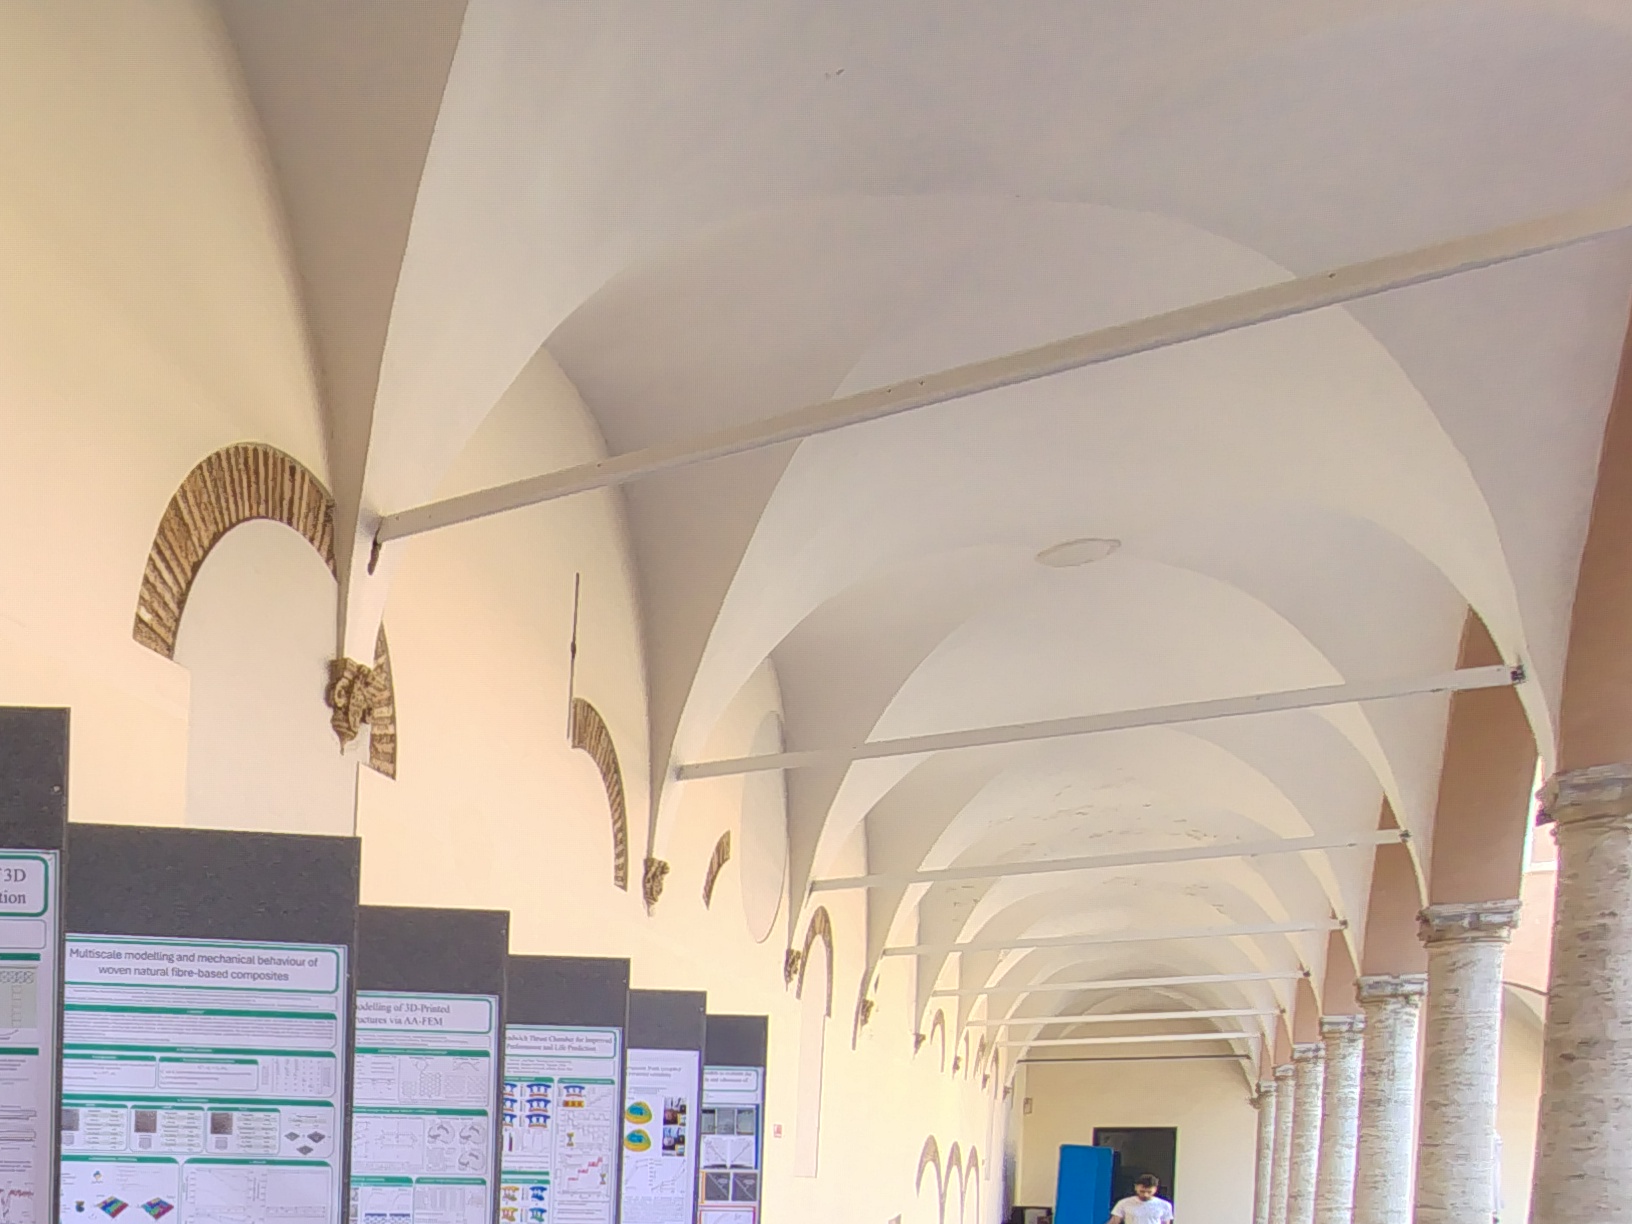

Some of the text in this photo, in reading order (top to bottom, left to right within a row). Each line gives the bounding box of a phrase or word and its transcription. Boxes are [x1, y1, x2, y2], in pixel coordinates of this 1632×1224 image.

[4, 868, 26, 883] 3D
[70, 948, 318, 967] Multiscale modelling and mechanical behaviour of
[98, 967, 288, 981] woven natural fibre-based composites
